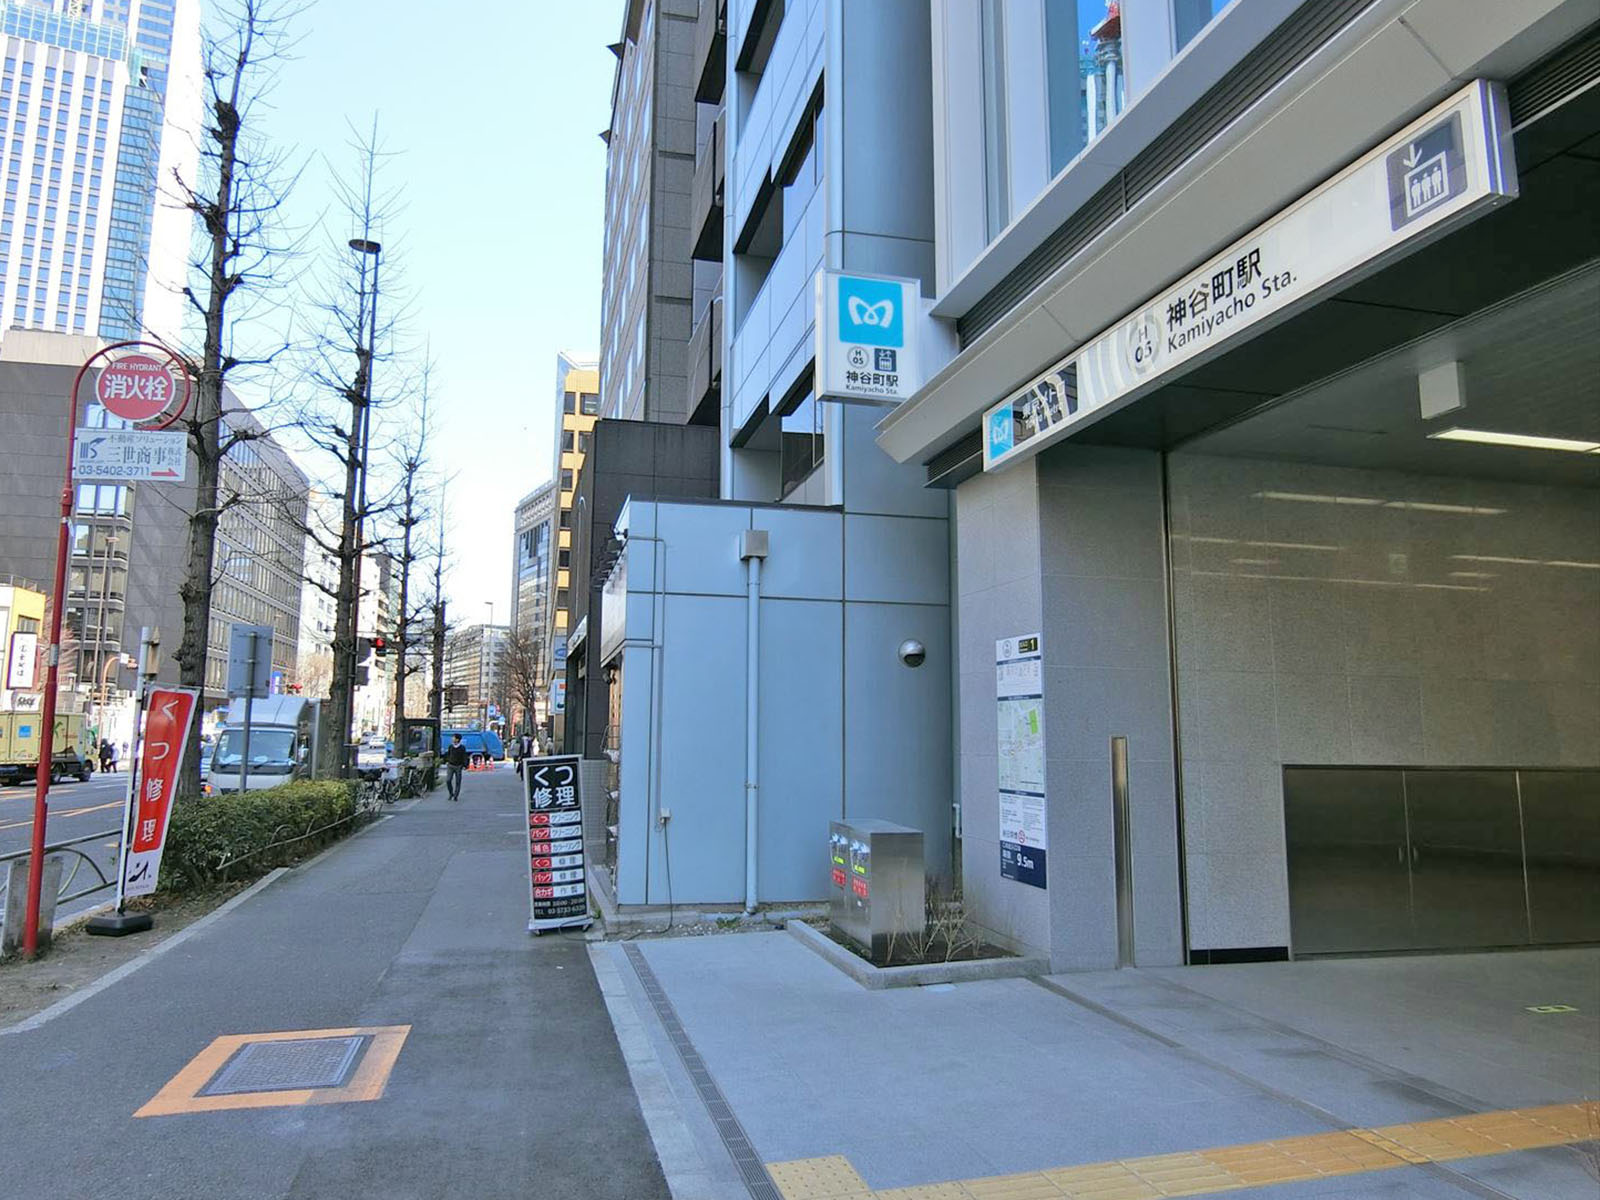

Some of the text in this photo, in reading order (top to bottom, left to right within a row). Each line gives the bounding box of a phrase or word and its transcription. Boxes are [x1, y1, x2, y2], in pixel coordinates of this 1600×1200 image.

[1166, 247, 1262, 332] 神谷町駅
[1167, 271, 1297, 353] Kamiyacho Sta.
[1138, 325, 1148, 343] H
[852, 356, 864, 365] 05
[1135, 341, 1152, 363] 05
[112, 362, 162, 372] FIRE HYDRANT
[104, 374, 168, 400] 消火栓
[846, 370, 899, 387] 神谷町駅
[845, 384, 885, 394] Kamiyacho
[79, 465, 150, 476] 03-5402-3711
[141, 700, 179, 843] くつ修理
[534, 766, 574, 786] くつ
[533, 785, 575, 809] 修理
